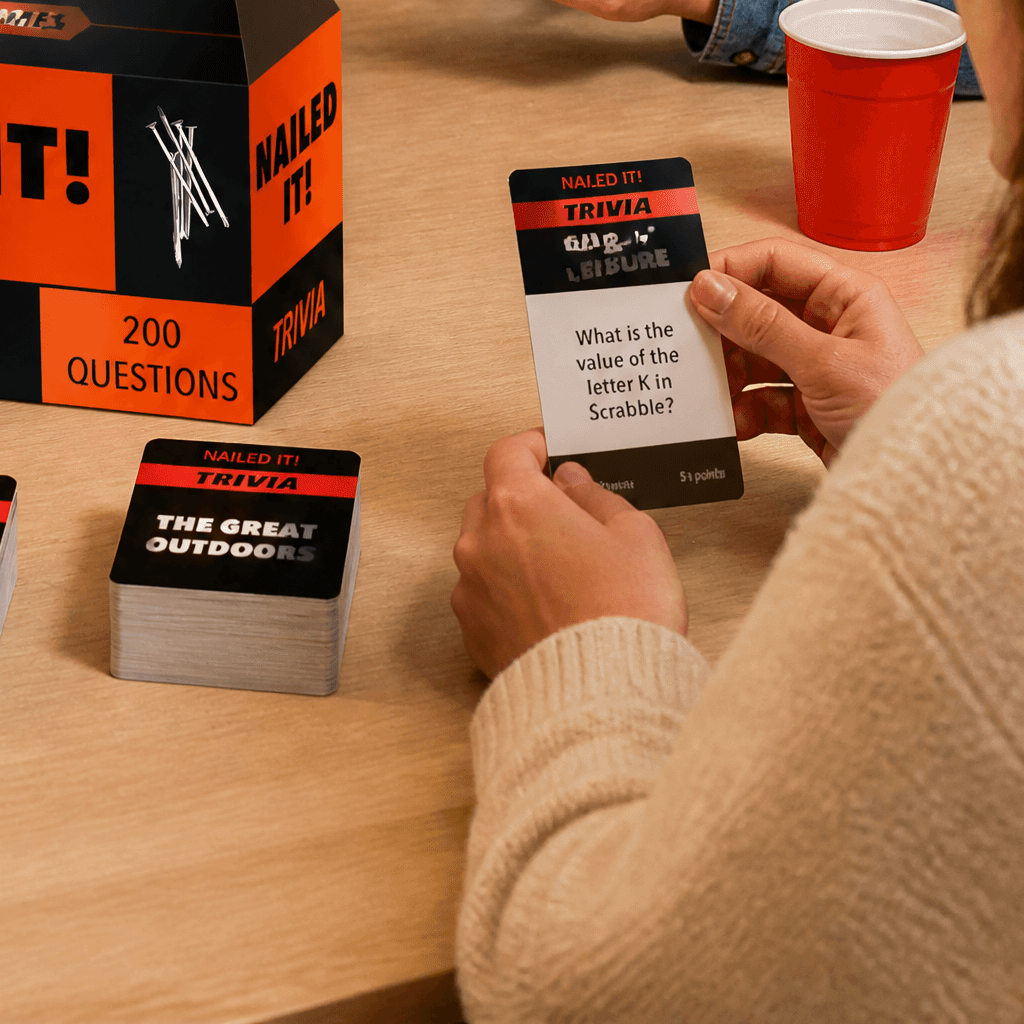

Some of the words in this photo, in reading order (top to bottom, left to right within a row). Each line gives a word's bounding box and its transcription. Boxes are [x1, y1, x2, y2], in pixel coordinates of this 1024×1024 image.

[256, 81, 337, 192] NAILED
[622, 170, 643, 184] IT!
[284, 158, 312, 226] IT!
[564, 197, 652, 221] TRIVIA
[123, 315, 181, 349] 200
[273, 280, 326, 363] TRIVIA
[575, 327, 622, 346] What
[627, 325, 641, 342] is
[645, 322, 674, 339] the
[576, 353, 624, 372] value
[629, 348, 646, 367] of
[650, 347, 680, 364] the
[67, 356, 238, 402] QUESTIONS
[587, 378, 634, 395] letter
[638, 374, 652, 391] K
[655, 374, 673, 390] in
[589, 397, 675, 420] Scrabble?
[203, 450, 271, 465] NAILED
[277, 455, 300, 467] IT!
[196, 472, 297, 490] TRIVIA
[156, 514, 215, 533] THE
[220, 518, 318, 539] GREAT
[145, 536, 316, 562] OUTDOORS
